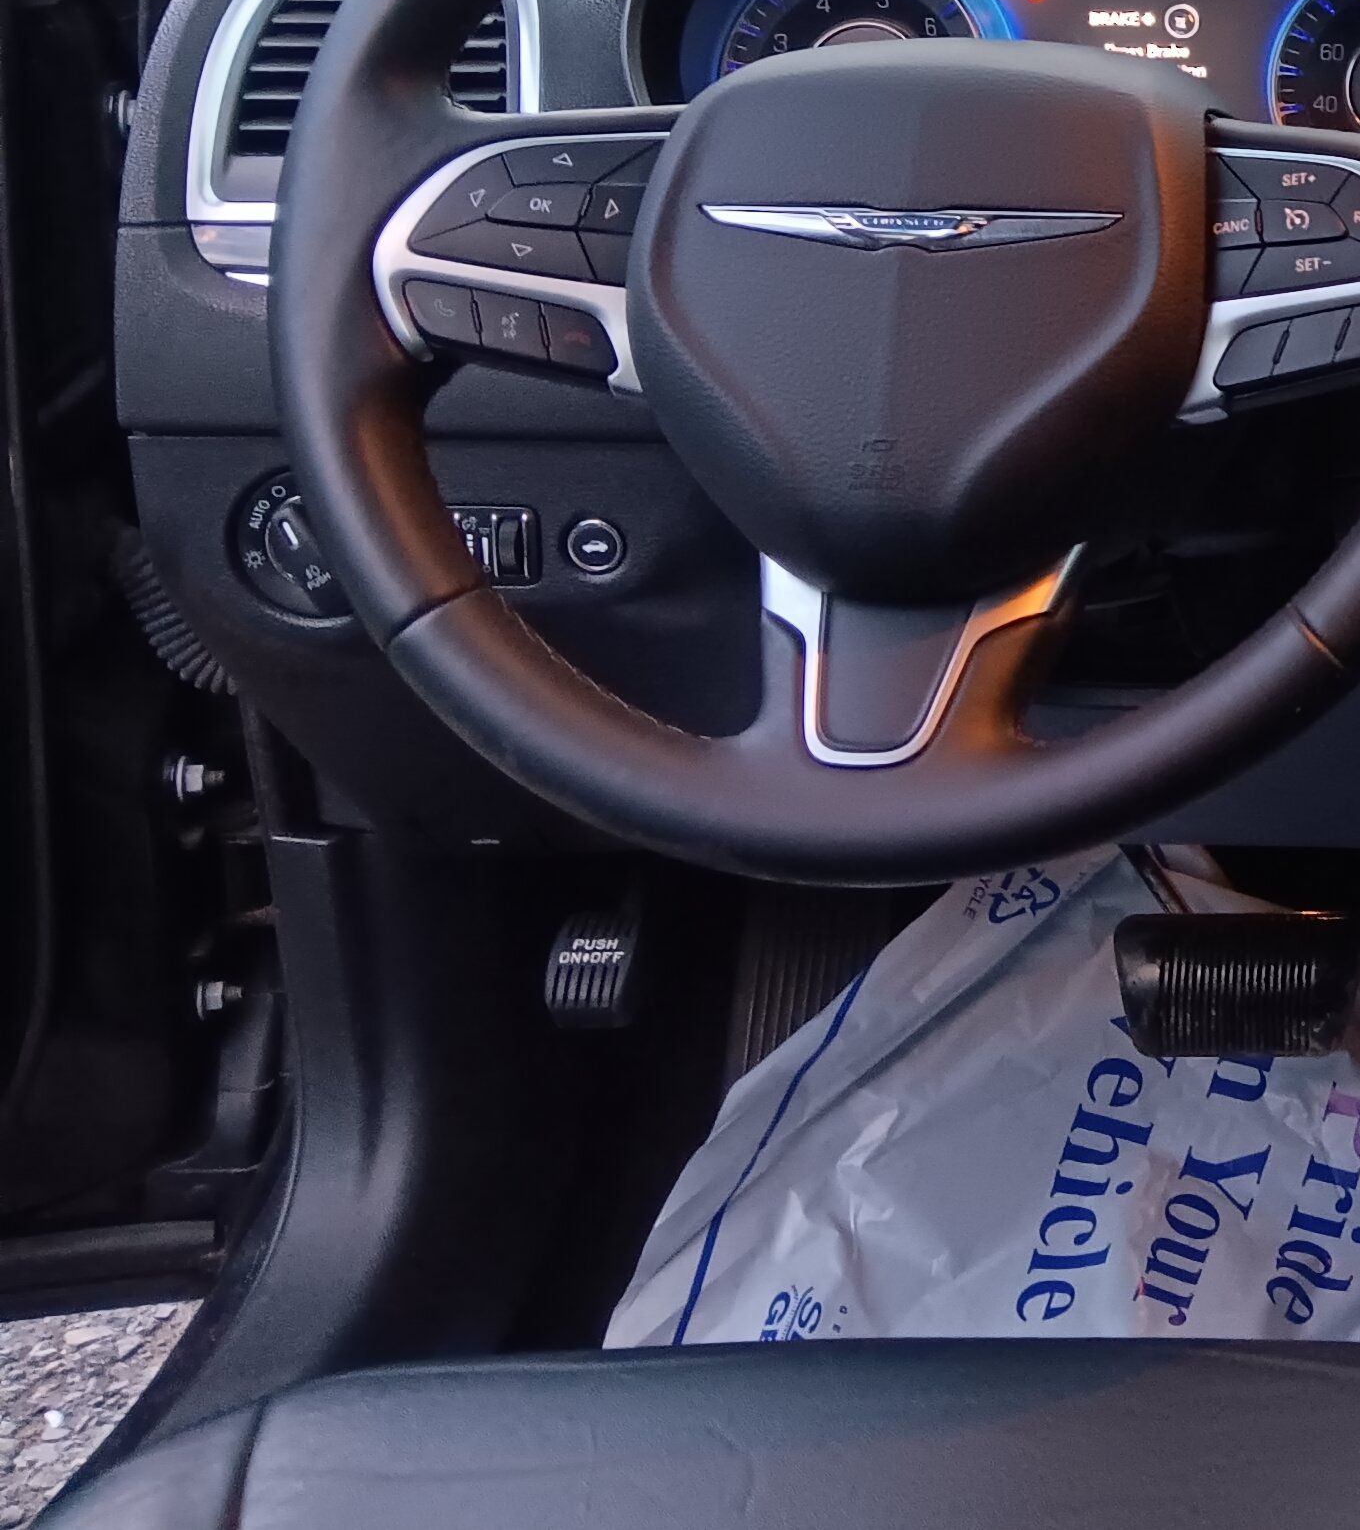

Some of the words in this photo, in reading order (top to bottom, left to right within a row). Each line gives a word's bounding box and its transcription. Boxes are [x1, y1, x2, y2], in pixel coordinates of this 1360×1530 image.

[924, 17, 937, 37] 6
[773, 33, 788, 53] 3
[1320, 43, 1345, 61] 60
[1312, 95, 1338, 113] 40
[529, 197, 553, 213] OK
[1212, 218, 1250, 235] CANC
[248, 499, 271, 530] AUTO
[963, 875, 993, 920] YCLE
[572, 937, 619, 950] PUSH
[1016, 1016, 1177, 1323] ehicle
[1132, 1144, 1272, 1327] Your
